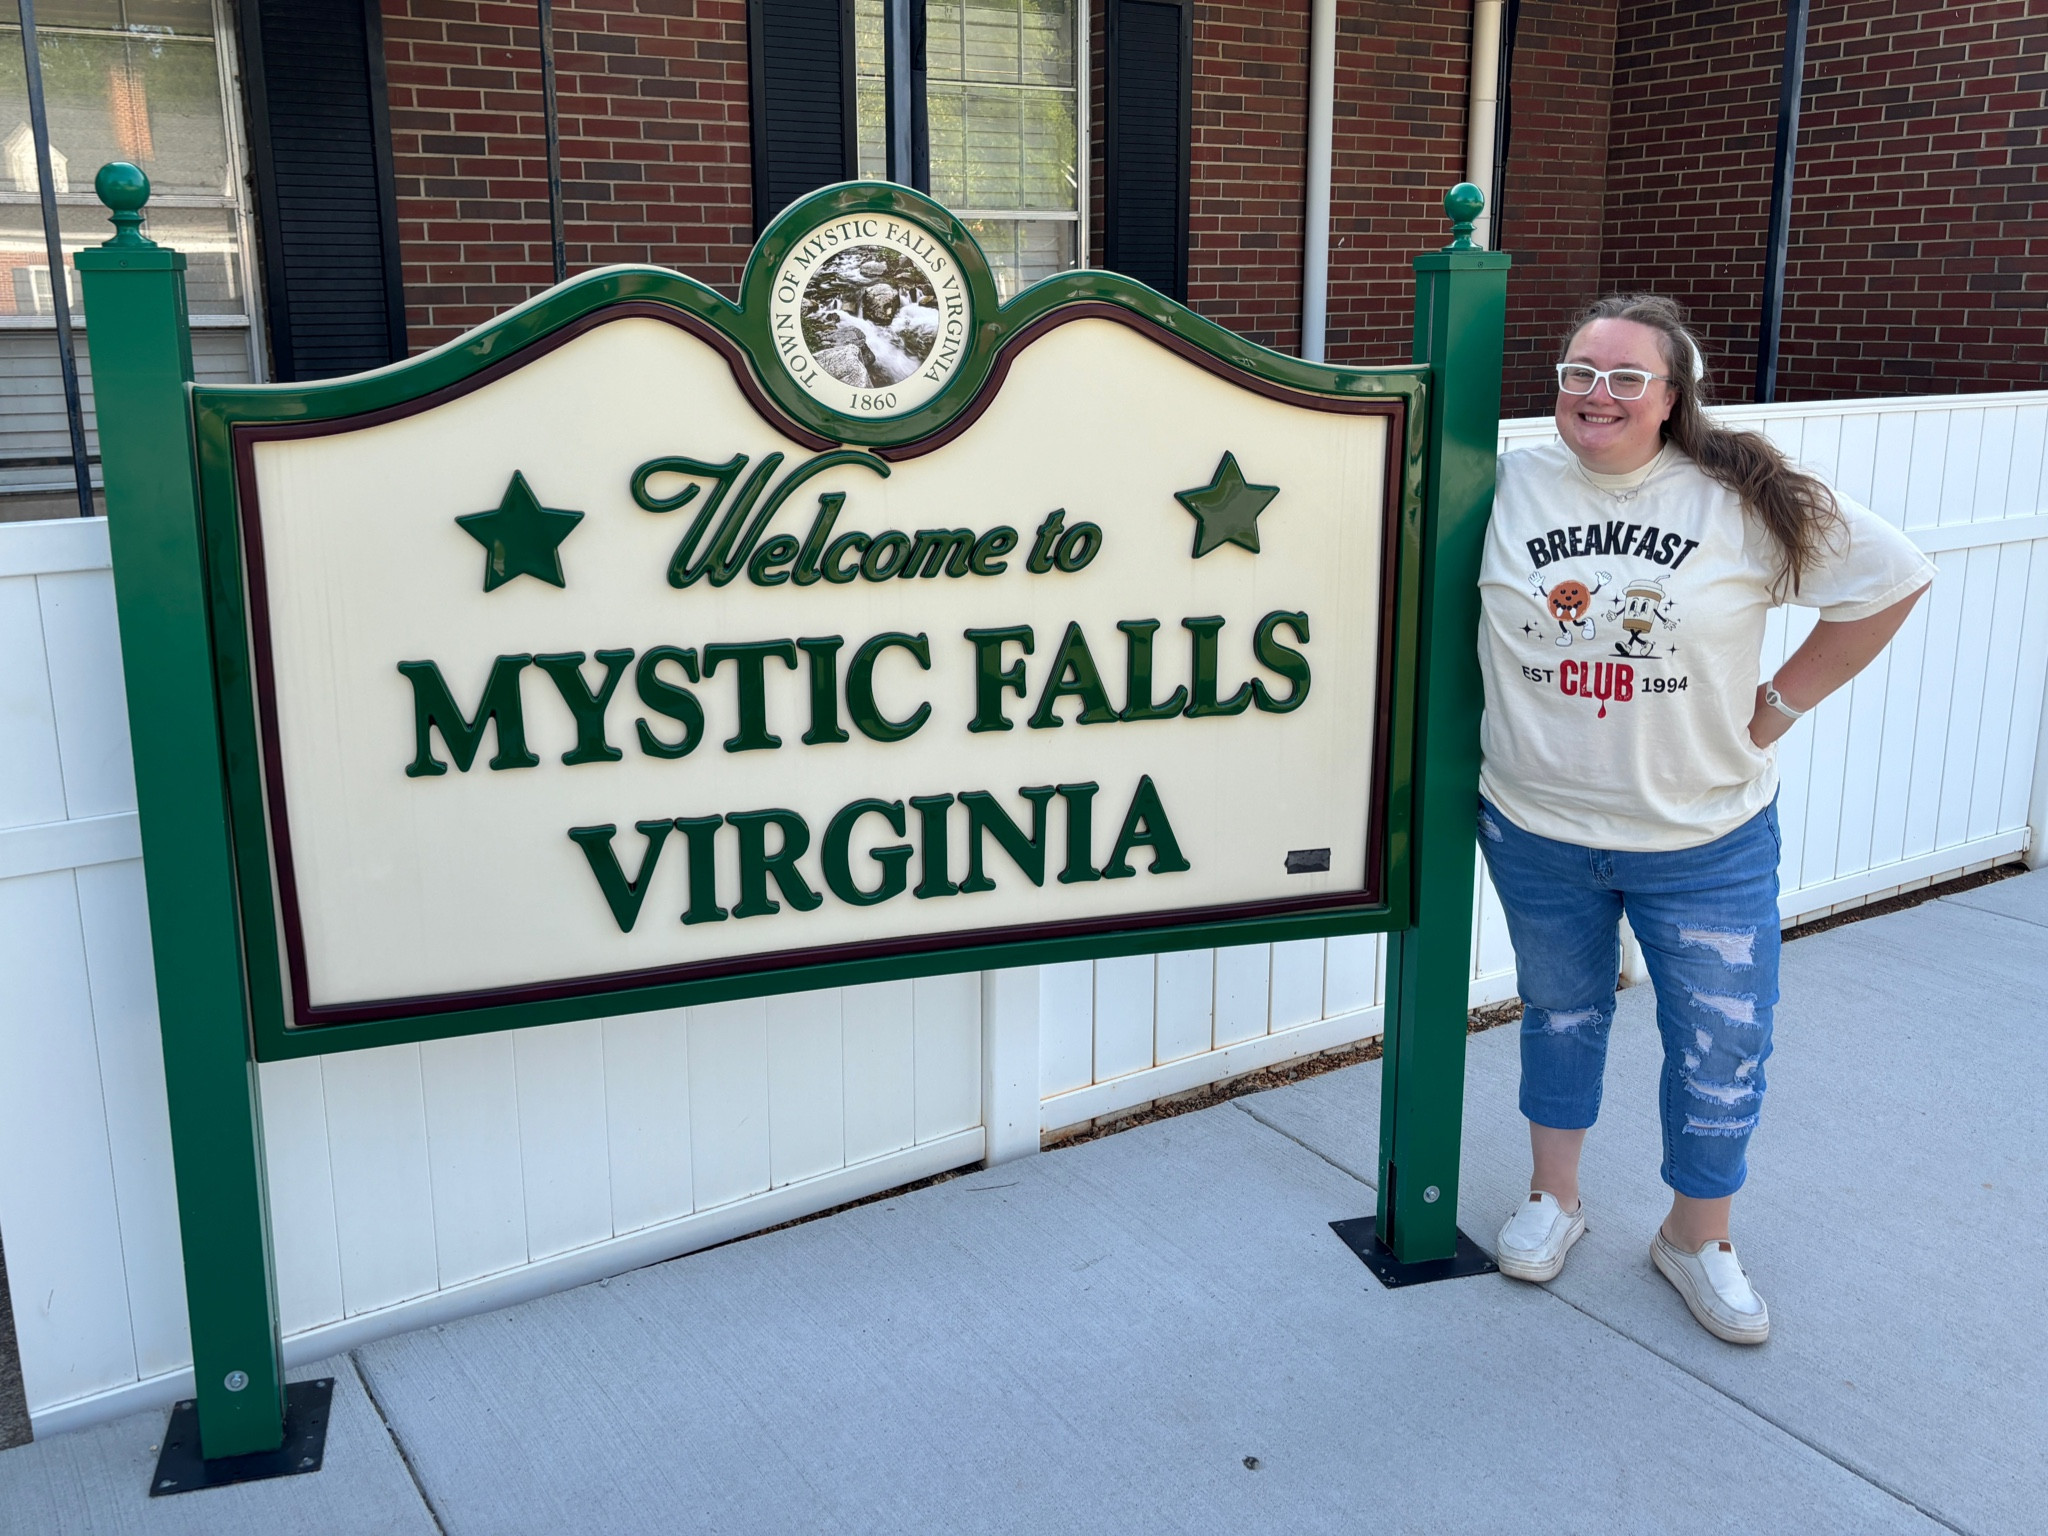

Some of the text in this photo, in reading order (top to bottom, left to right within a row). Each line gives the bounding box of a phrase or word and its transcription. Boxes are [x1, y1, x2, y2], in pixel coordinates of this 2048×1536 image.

[776, 219, 963, 389] TOWN OF MYSTIC FALLS VIRGINIA
[849, 392, 897, 411] 1860
[629, 450, 1103, 590] Welcome to
[1526, 520, 1700, 570] BREAKFAST
[397, 609, 1311, 779] MYSTIC FALLS
[1521, 659, 1688, 702] EST CLUB 1994
[567, 773, 1192, 934] VIRGINIA
